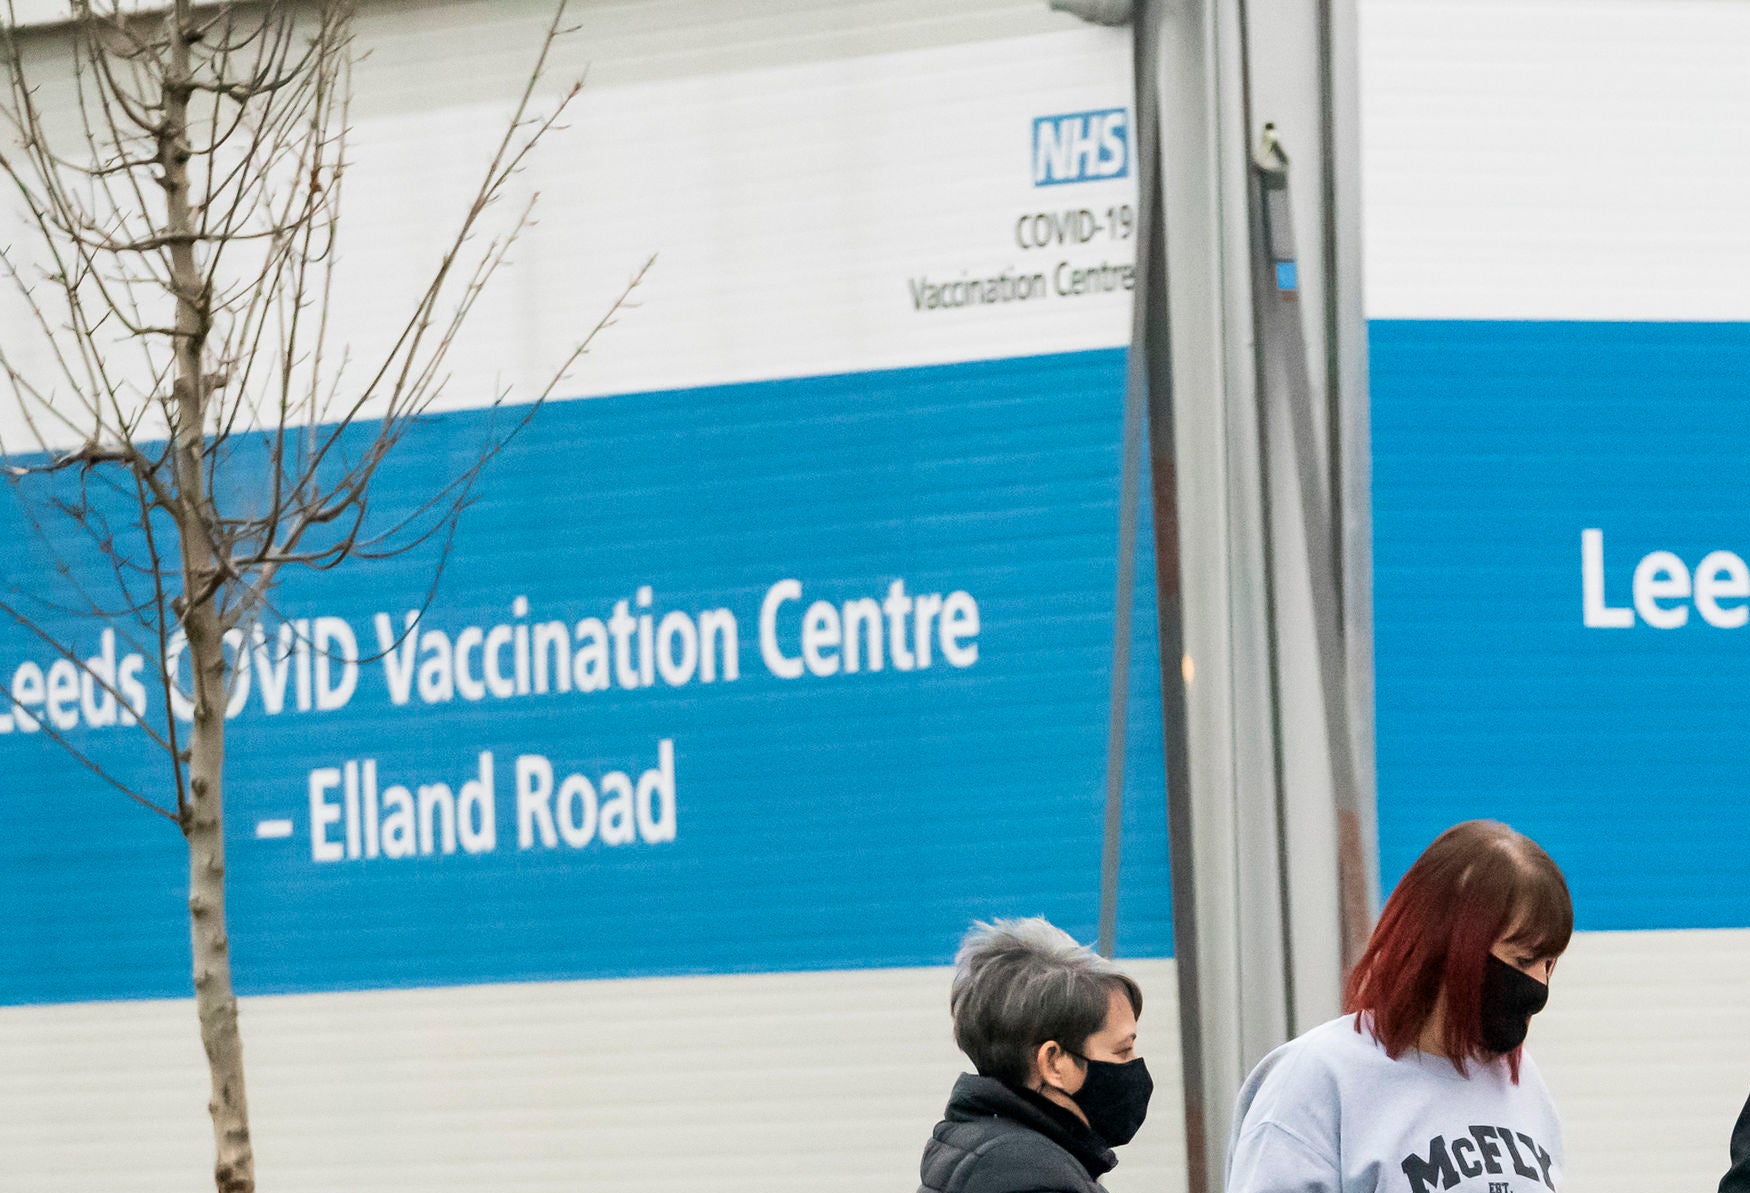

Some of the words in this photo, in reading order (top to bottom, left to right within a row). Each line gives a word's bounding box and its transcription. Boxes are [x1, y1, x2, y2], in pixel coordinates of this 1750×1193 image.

[1035, 112, 1126, 183] NHS
[1015, 204, 1134, 250] COVID-19
[907, 264, 1046, 312] Vaccination
[0, 627, 146, 733] eeds
[374, 586, 739, 706] Vaccination
[759, 579, 980, 679] Centre
[308, 750, 496, 863] Elland
[515, 738, 677, 850] Road
